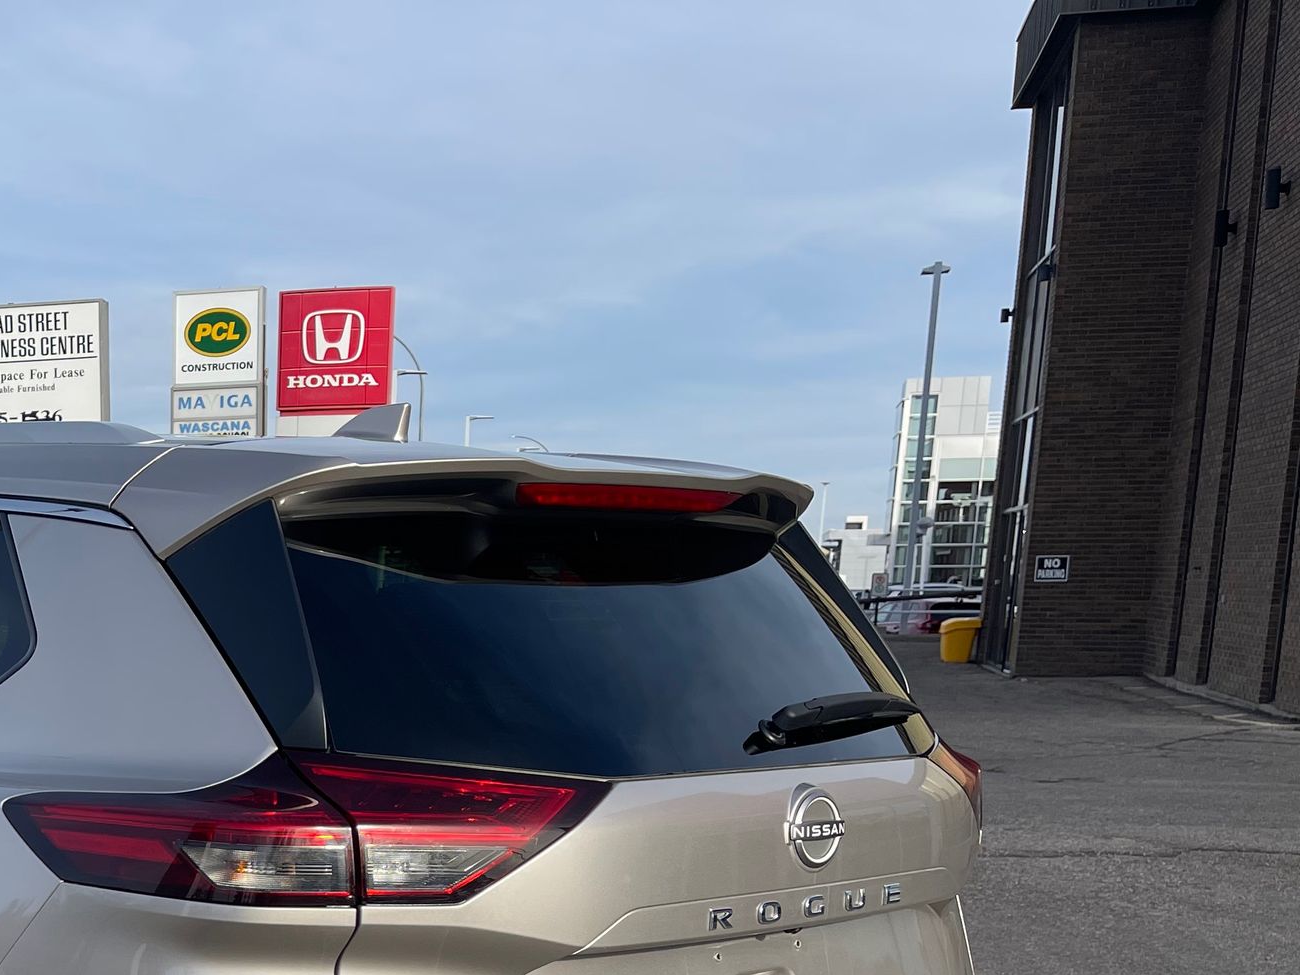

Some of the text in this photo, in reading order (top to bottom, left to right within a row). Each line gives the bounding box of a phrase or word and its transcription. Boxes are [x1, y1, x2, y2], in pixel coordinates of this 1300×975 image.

[18, 311, 69, 333] STREET
[194, 320, 241, 343] PCL
[40, 334, 94, 356] CENTRE
[30, 368, 48, 380] For
[54, 367, 85, 378] Lease
[181, 361, 253, 373] CONSTRUCTION
[17, 383, 56, 393] Furnished
[286, 373, 379, 389] HONDA
[179, 420, 251, 434] WASCANA
[1044, 558, 1061, 568] NO
[792, 820, 845, 839] NISSAN
[708, 882, 901, 932] ROGUE
